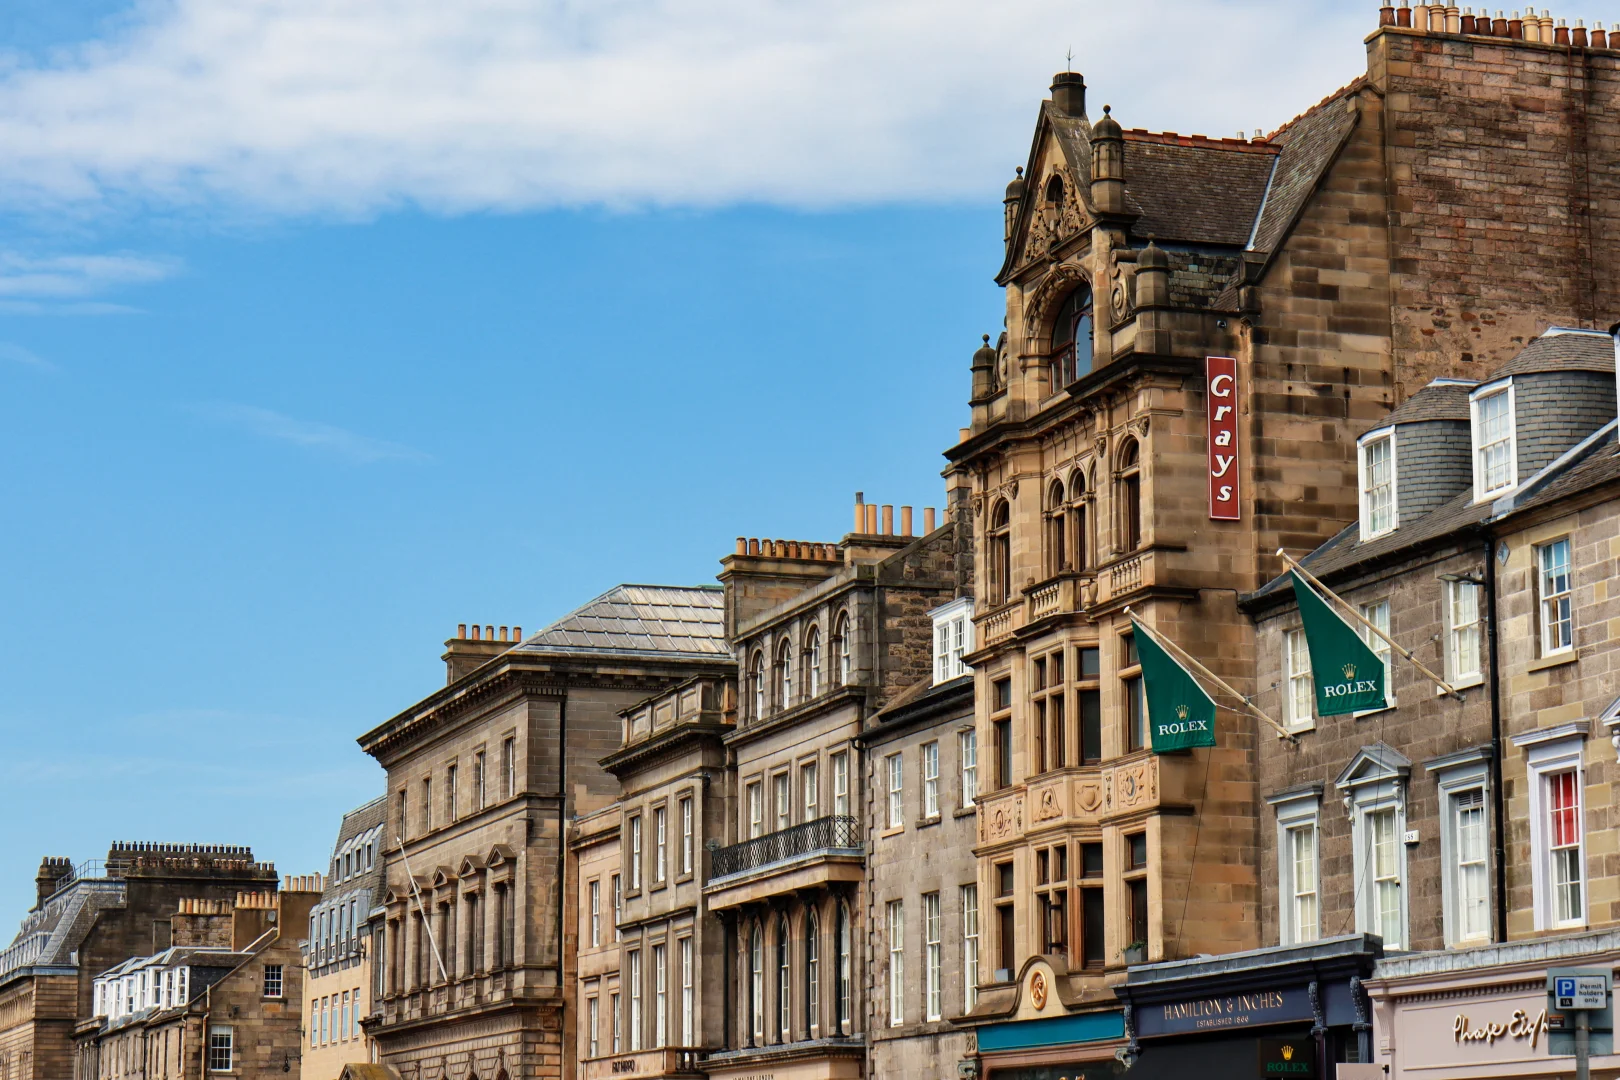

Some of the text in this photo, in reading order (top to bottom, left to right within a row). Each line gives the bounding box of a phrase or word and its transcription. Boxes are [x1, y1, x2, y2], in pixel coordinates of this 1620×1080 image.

[1210, 374, 1234, 502] Grays
[1324, 680, 1378, 698] ROLEX
[1158, 720, 1208, 736] ROLEX
[1561, 981, 1573, 995] P
[1163, 991, 1283, 1020] HAMILTON & INCHES
[1196, 1017, 1232, 1028] ESTABLISHED
[1452, 1008, 1548, 1048] Phase Eigh
[1266, 1062, 1309, 1072] ROLEX
